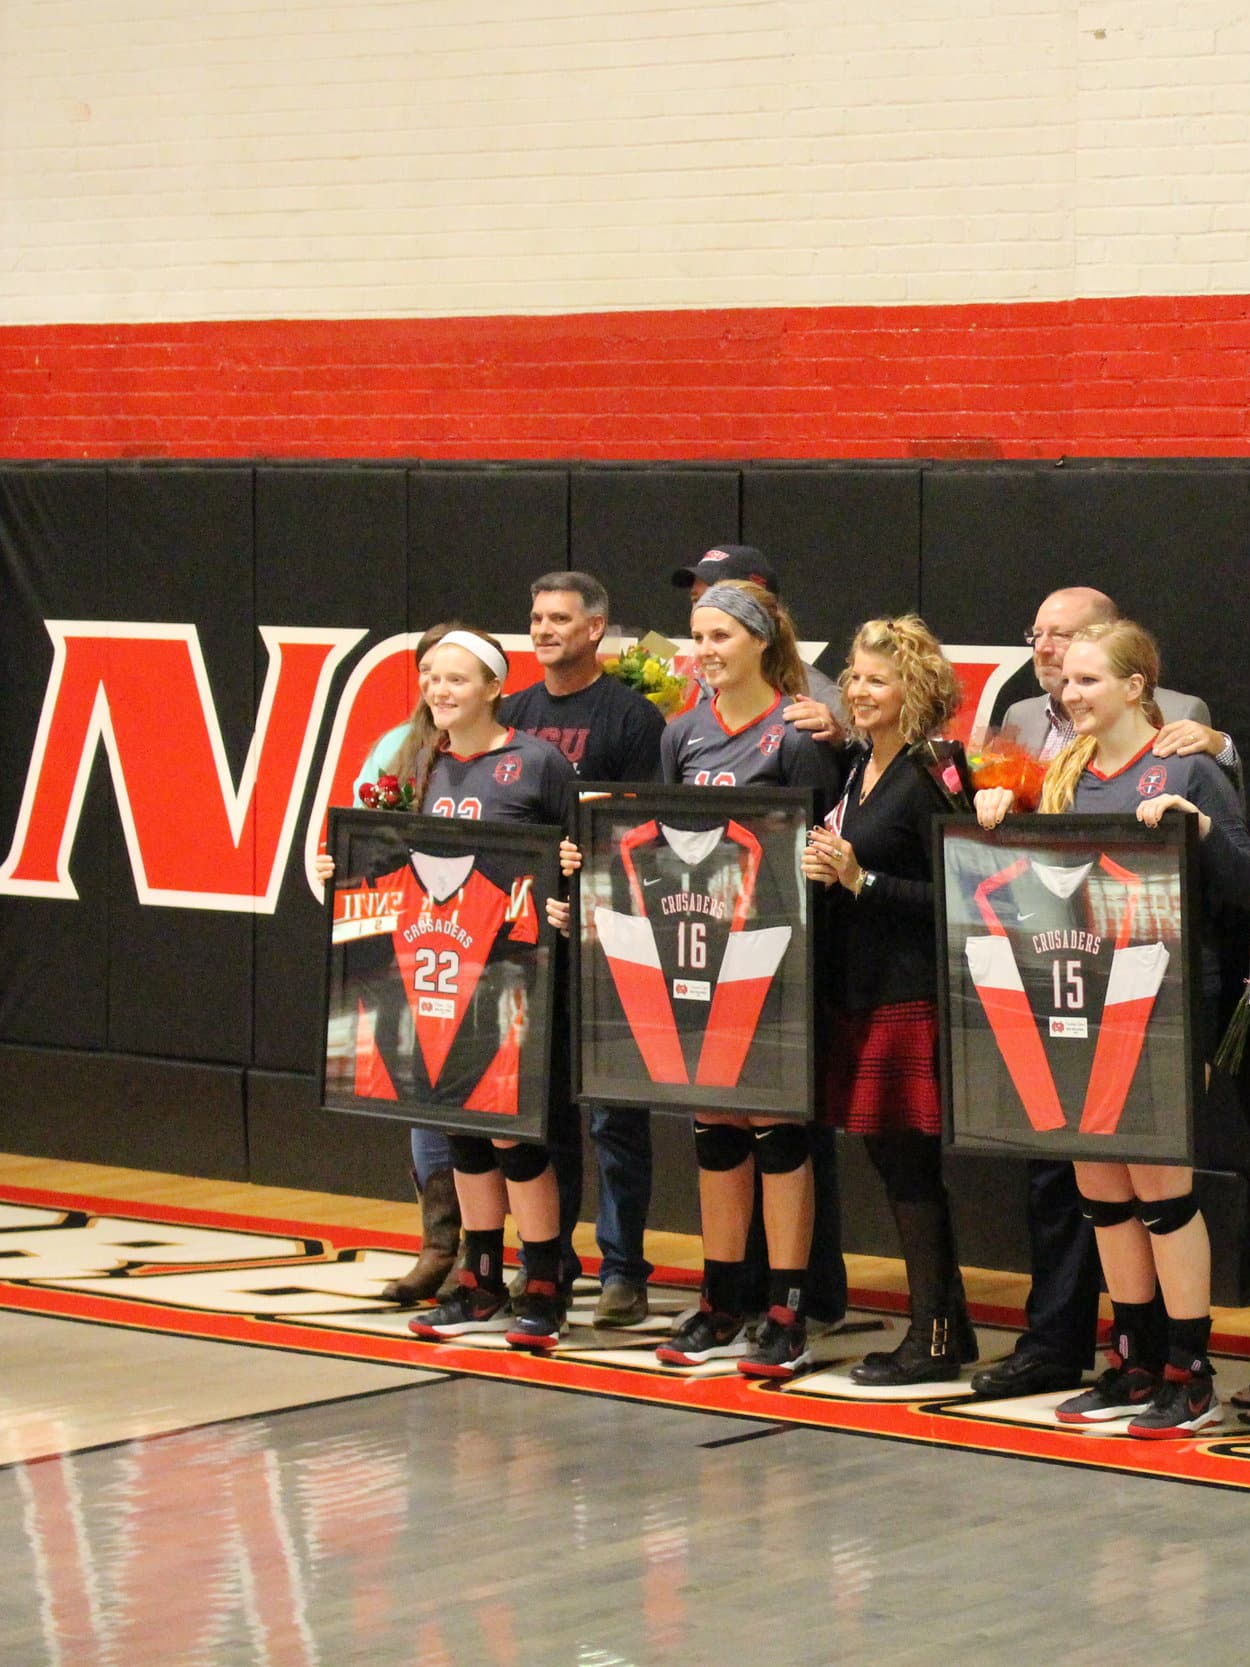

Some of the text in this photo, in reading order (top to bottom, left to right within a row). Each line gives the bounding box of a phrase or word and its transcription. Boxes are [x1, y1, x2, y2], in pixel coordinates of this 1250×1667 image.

[661, 892, 726, 919] CRUSADERS
[403, 919, 473, 949] CRUSADERS
[677, 921, 707, 969] 16
[1032, 929, 1101, 956] CRUSADERS
[413, 947, 460, 994] 22
[1052, 959, 1084, 1009] 15
